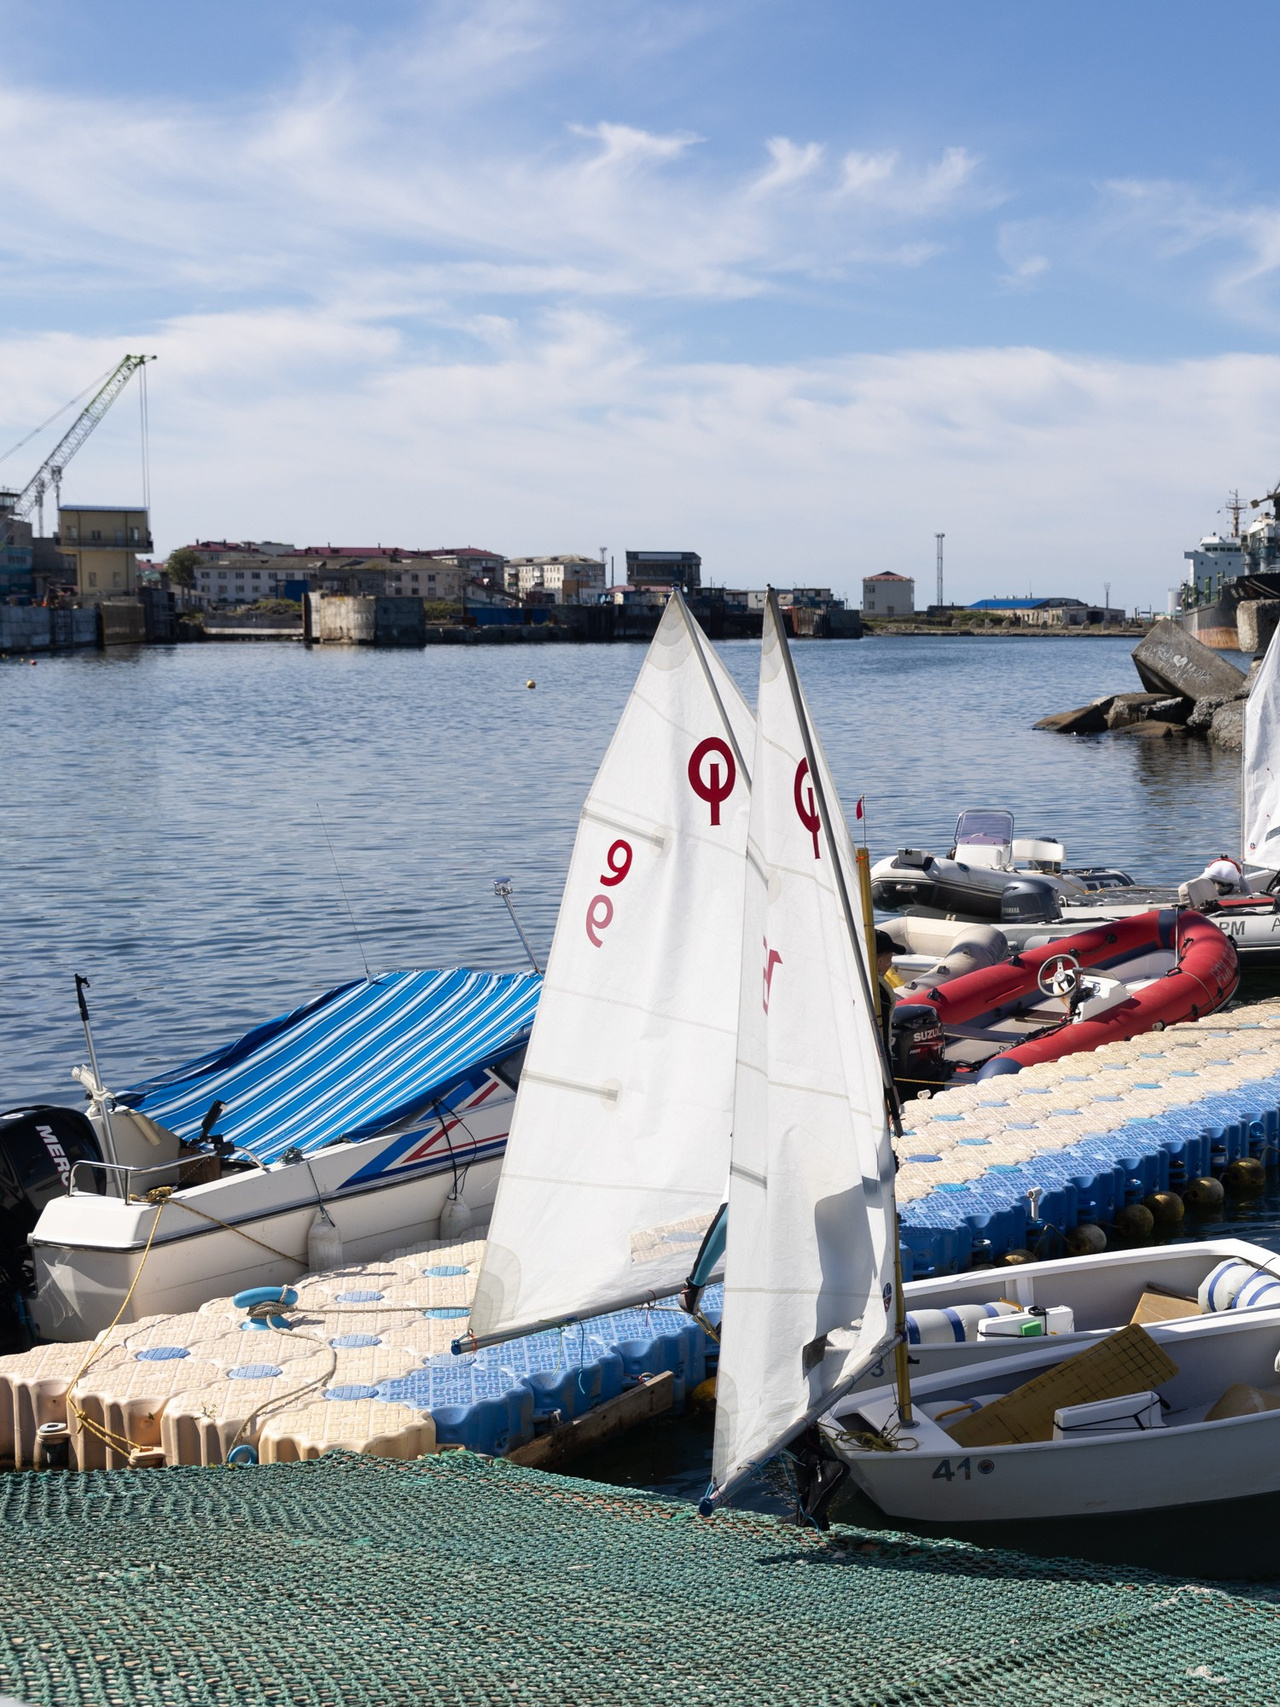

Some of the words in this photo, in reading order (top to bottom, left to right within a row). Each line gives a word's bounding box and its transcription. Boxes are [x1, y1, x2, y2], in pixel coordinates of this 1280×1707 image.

[600, 839, 633, 887] 9
[35, 1125, 80, 1192] MERC
[932, 1457, 972, 1482] 41
